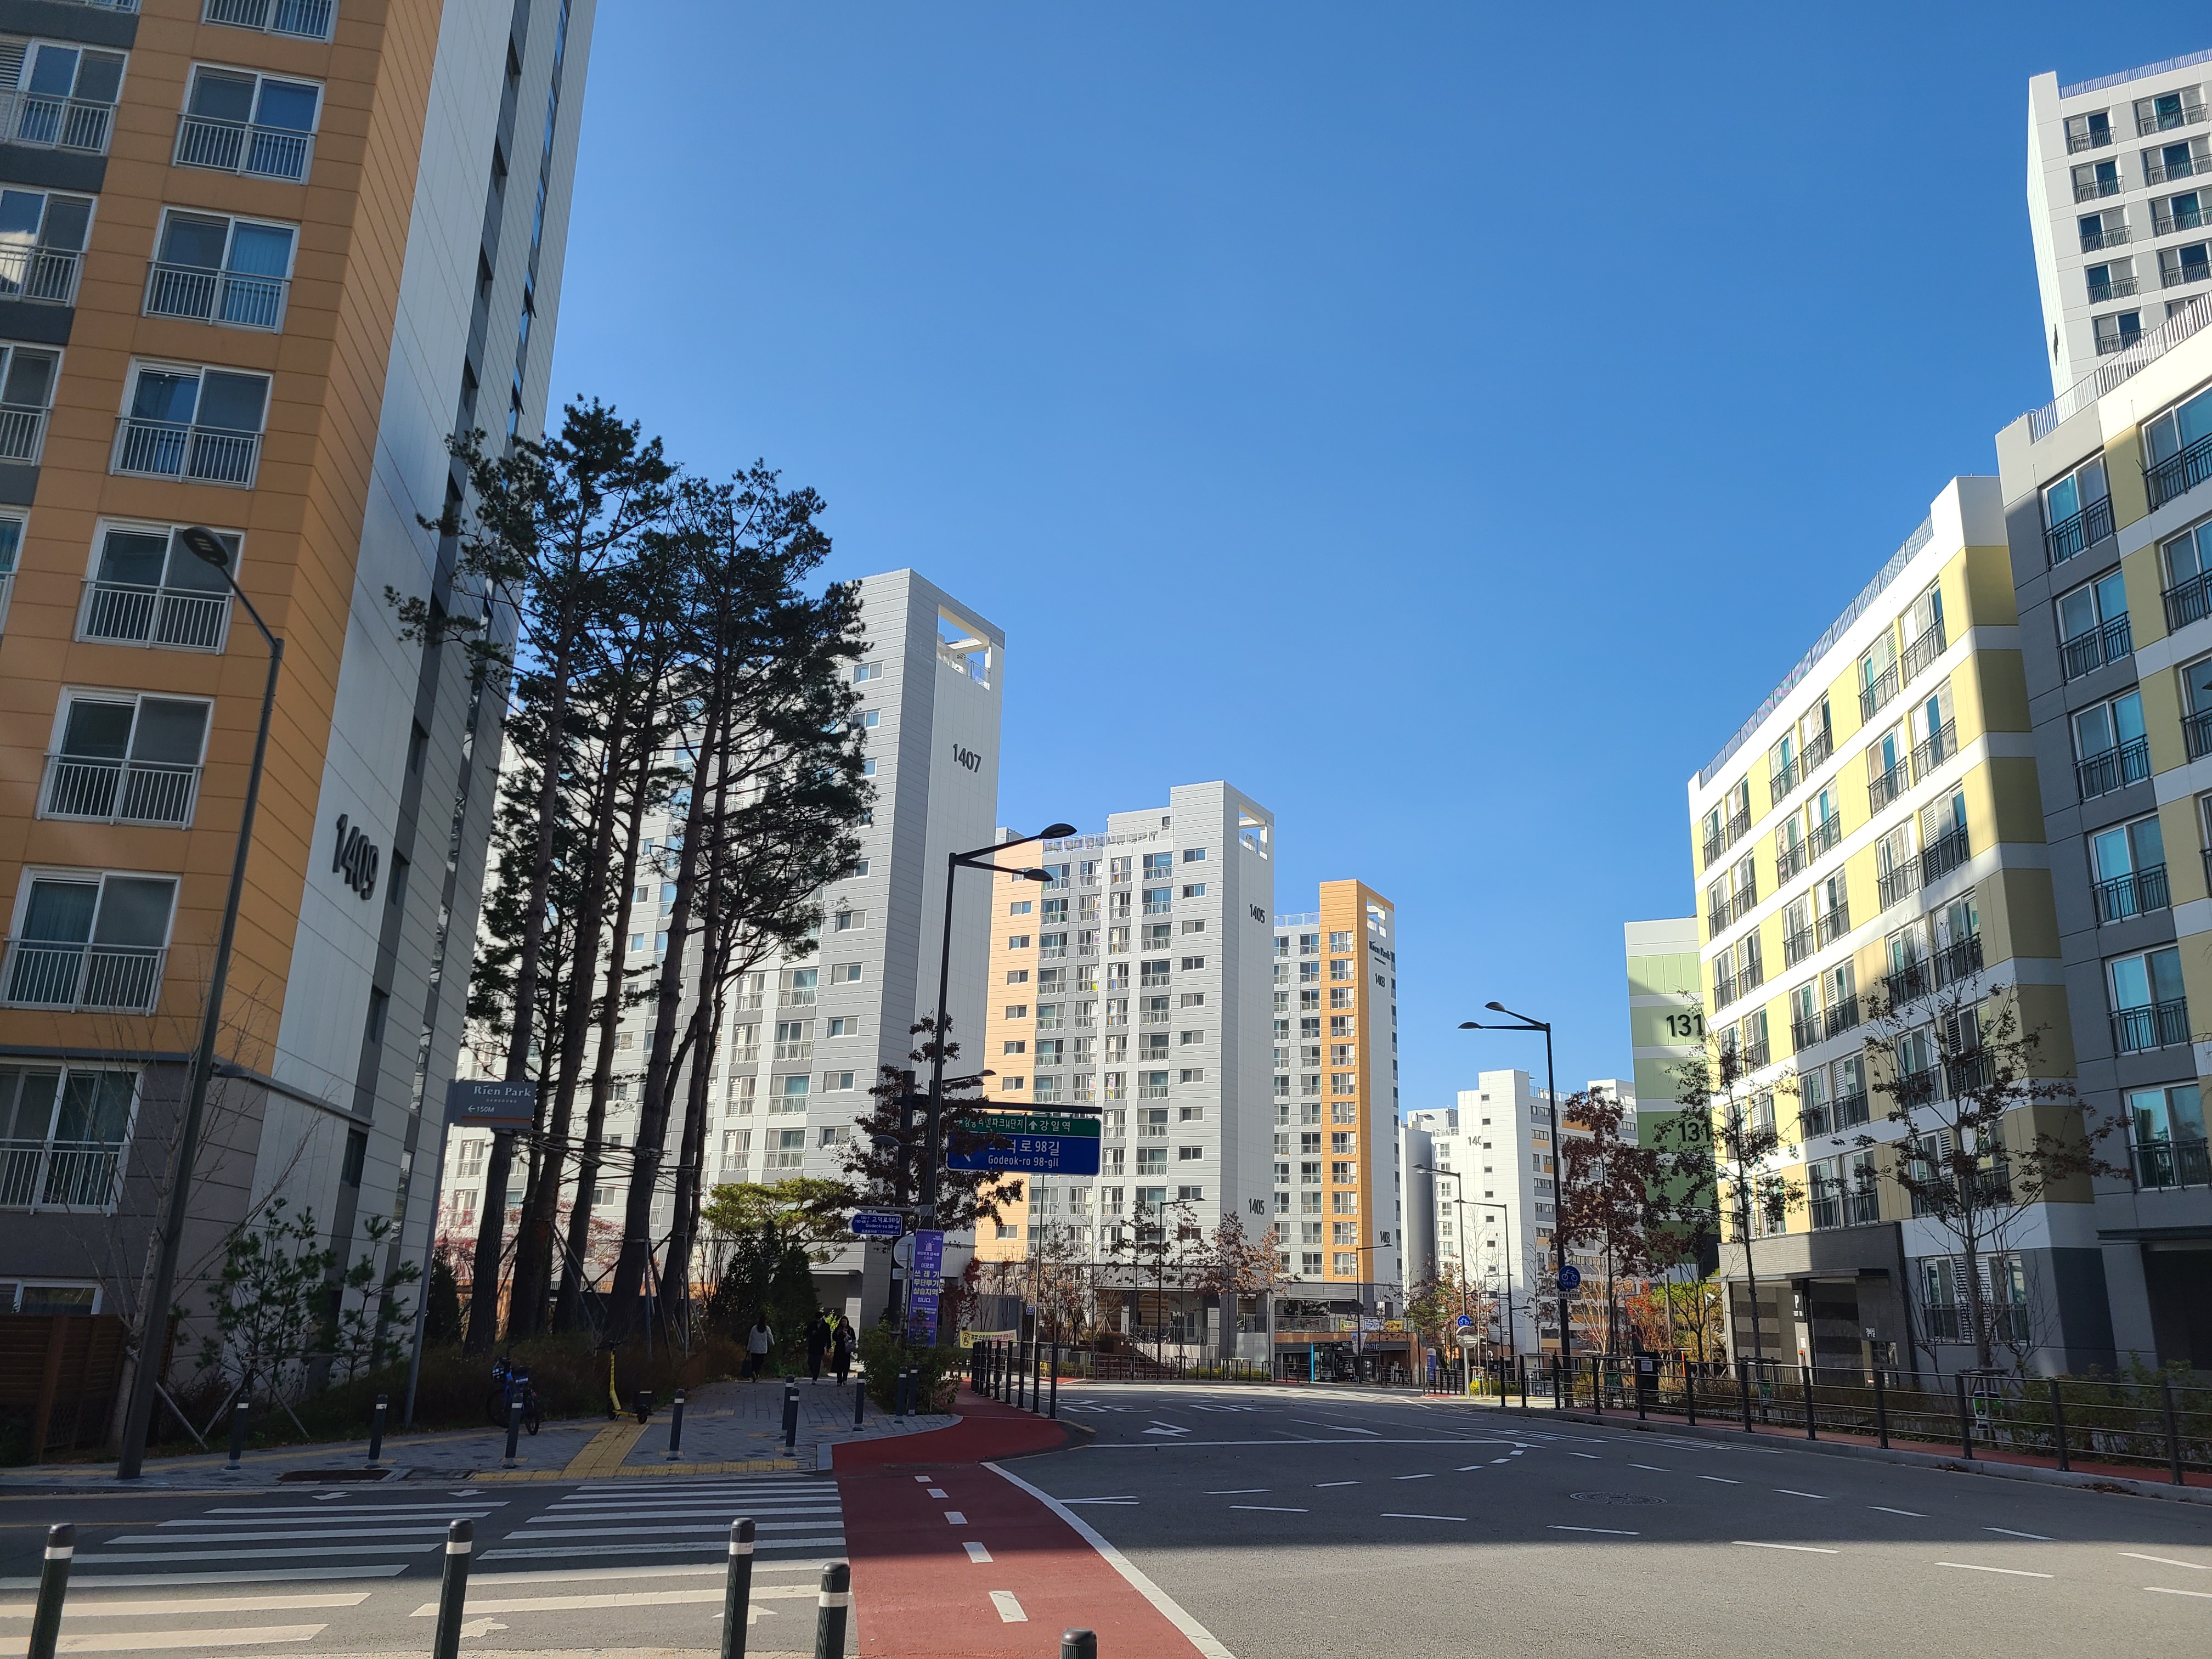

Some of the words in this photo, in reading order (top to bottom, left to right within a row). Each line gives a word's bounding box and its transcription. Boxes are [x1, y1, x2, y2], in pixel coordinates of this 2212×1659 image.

[953, 743, 981, 772] 1407
[332, 814, 379, 900] 1409
[1249, 904, 1265, 923] 1405
[1375, 973, 1385, 988] 1403
[505, 1087, 531, 1096] Park
[1040, 1120, 1070, 1132] 강일역
[988, 1155, 1031, 1166] Godeok-ro
[1034, 1157, 1059, 1169] 98-gil
[1249, 1198, 1265, 1215] 1405
[1380, 1231, 1390, 1243] 1403
[913, 1279, 939, 1287] 무단투기
[913, 1288, 938, 1296] 상습지역
[1794, 1295, 1799, 1309] P
